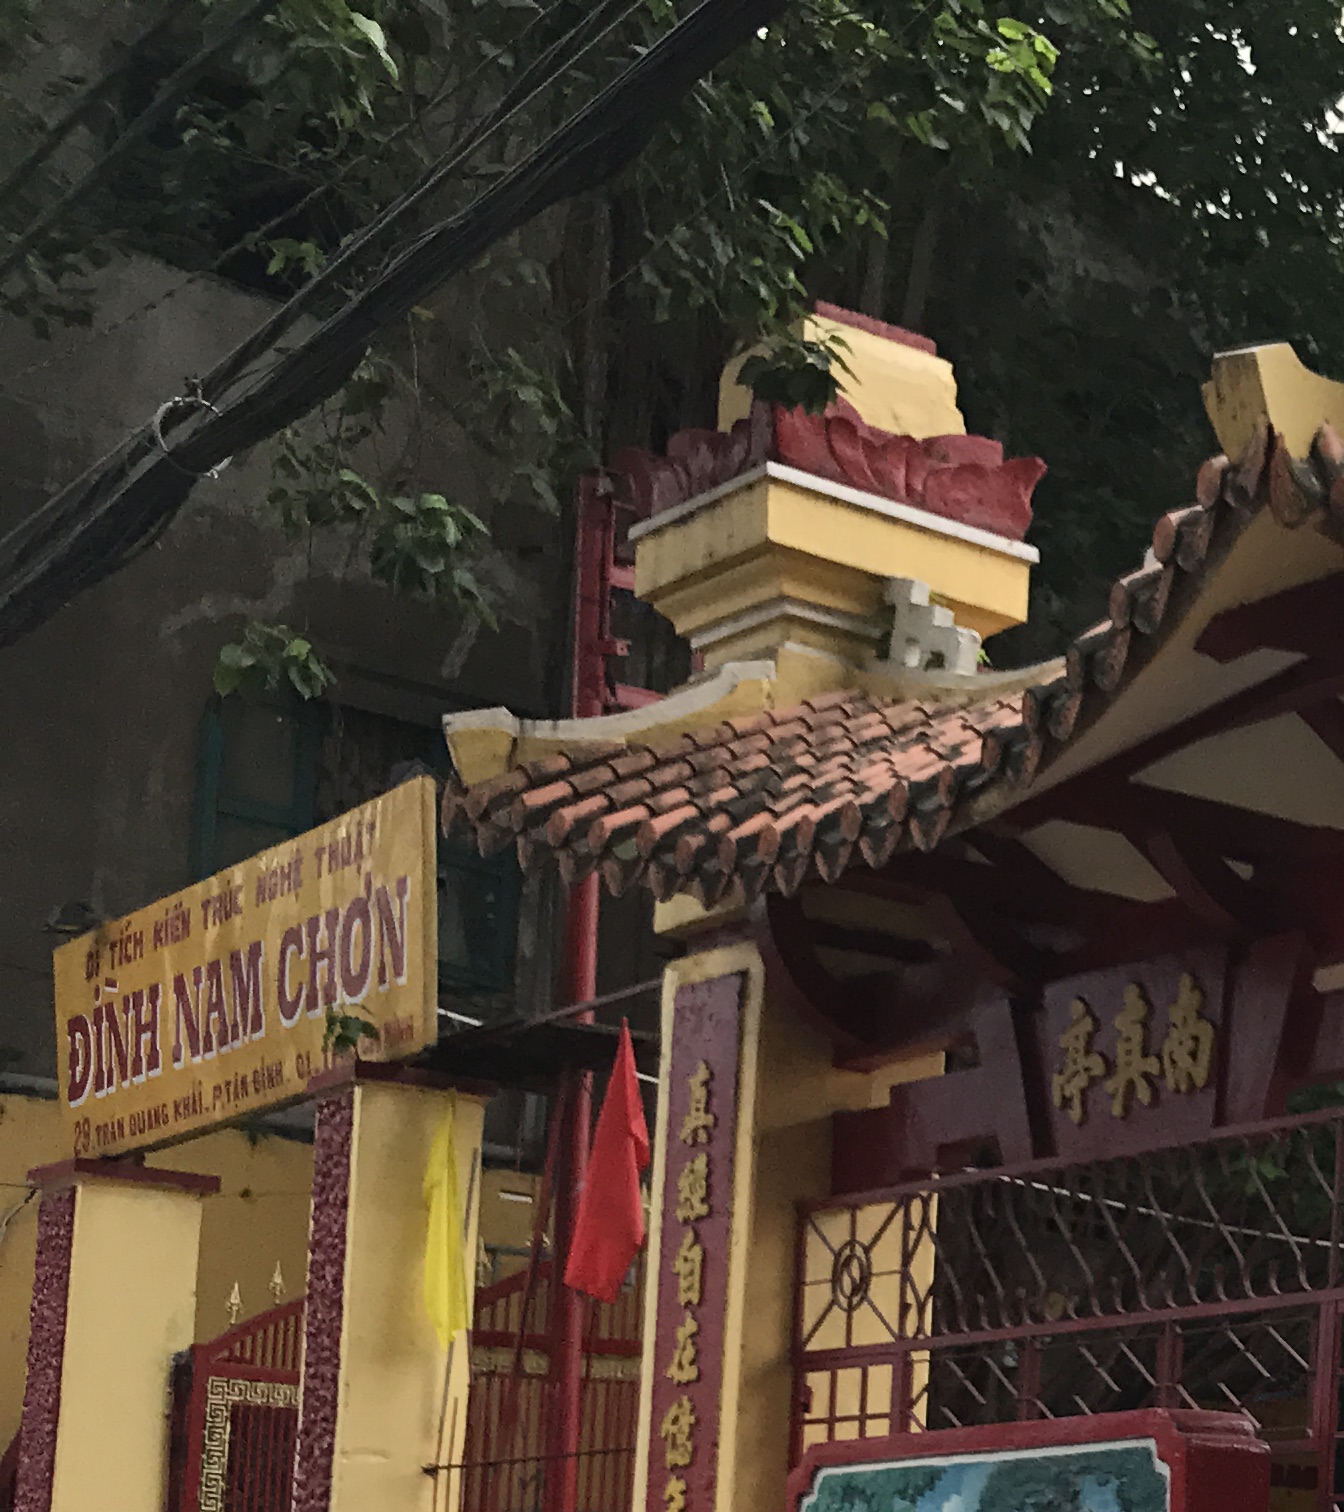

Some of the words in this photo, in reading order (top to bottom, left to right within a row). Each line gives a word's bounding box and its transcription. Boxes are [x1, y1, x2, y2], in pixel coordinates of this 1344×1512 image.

[109, 920, 144, 970] TÍCH
[67, 977, 163, 1108] ĐÌNH
[172, 938, 266, 1071] NAM
[276, 870, 411, 1030] CHƠN
[129, 1102, 170, 1136] QUANG
